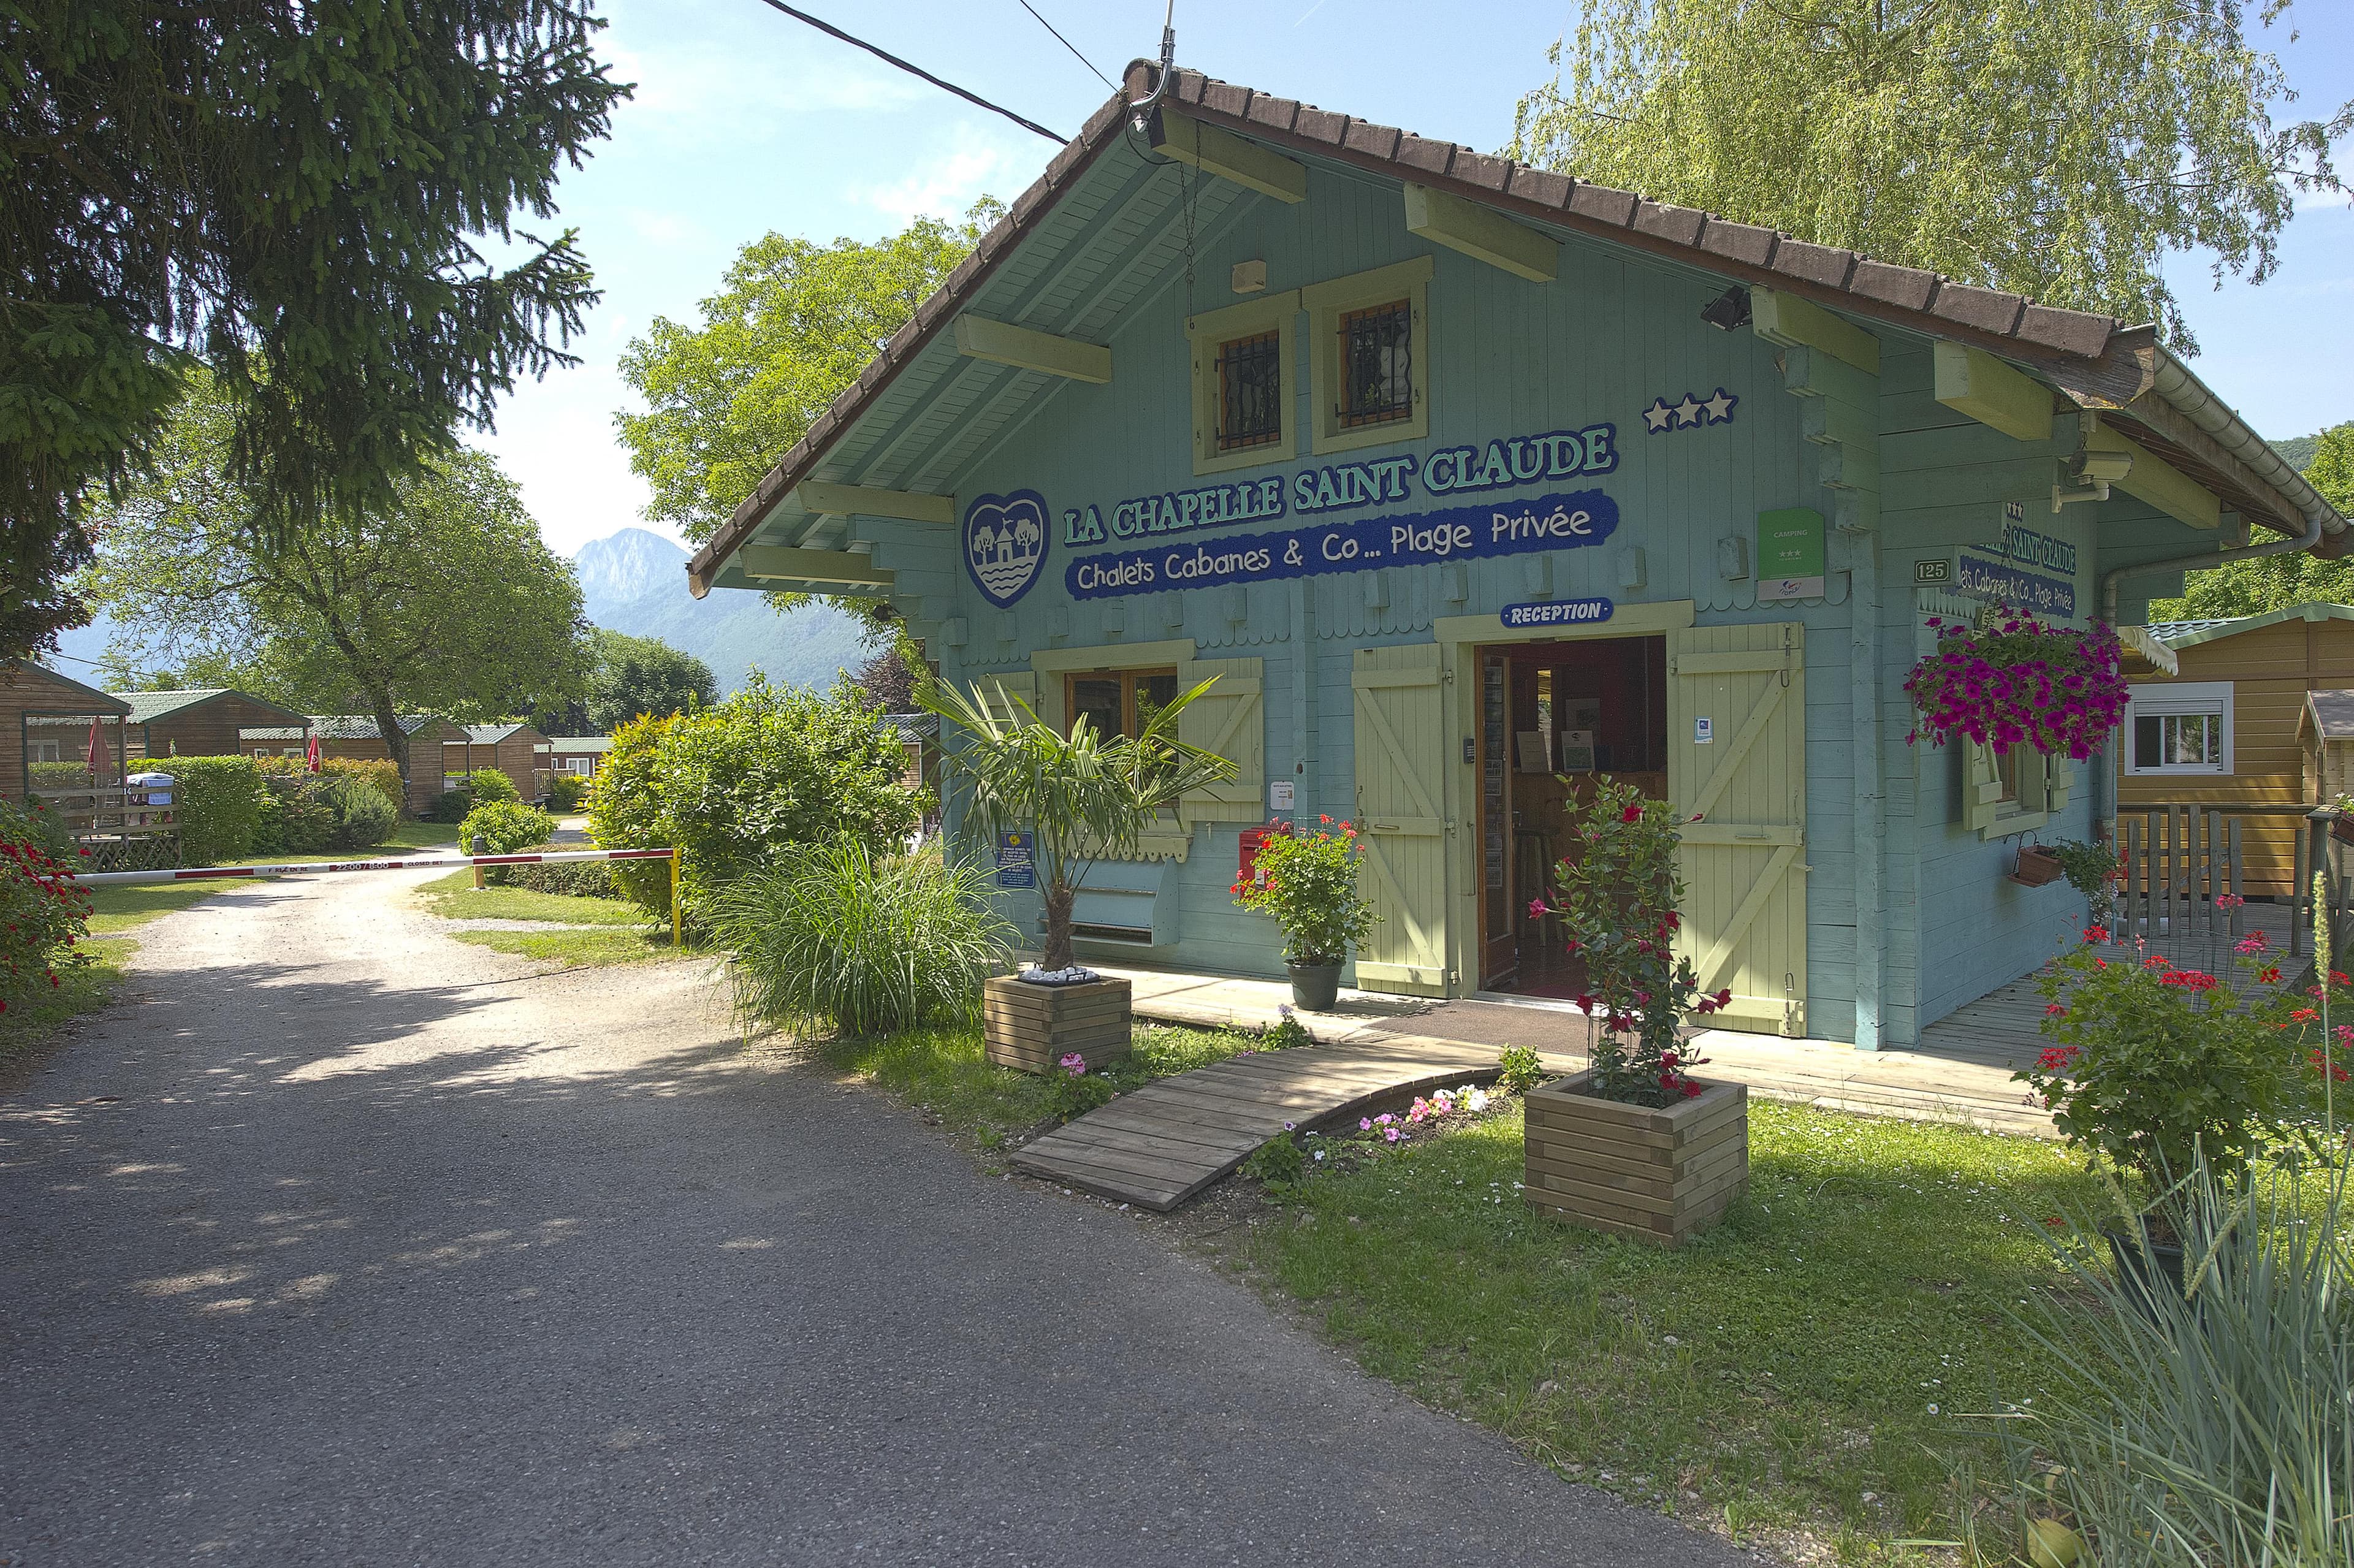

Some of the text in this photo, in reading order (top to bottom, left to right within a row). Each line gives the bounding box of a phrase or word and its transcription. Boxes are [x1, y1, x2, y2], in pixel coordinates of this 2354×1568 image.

[1064, 428, 1612, 544] LA CHAPELLE SAINT CLAUDE
[1078, 557, 1154, 590] Chalets
[1165, 547, 1271, 579] Cabanes
[1284, 539, 1303, 566] &
[1392, 523, 1472, 555] Plage
[1492, 506, 1591, 542] Privée
[1773, 529, 1808, 538] CAMPING
[2013, 530, 2040, 562] SAINT
[2042, 539, 2076, 573] CLAUDE
[1919, 564, 1944, 578] 125
[2035, 582, 2052, 609] Plage
[2055, 587, 2072, 611] Privée
[1511, 602, 1602, 624] RECEPTION
